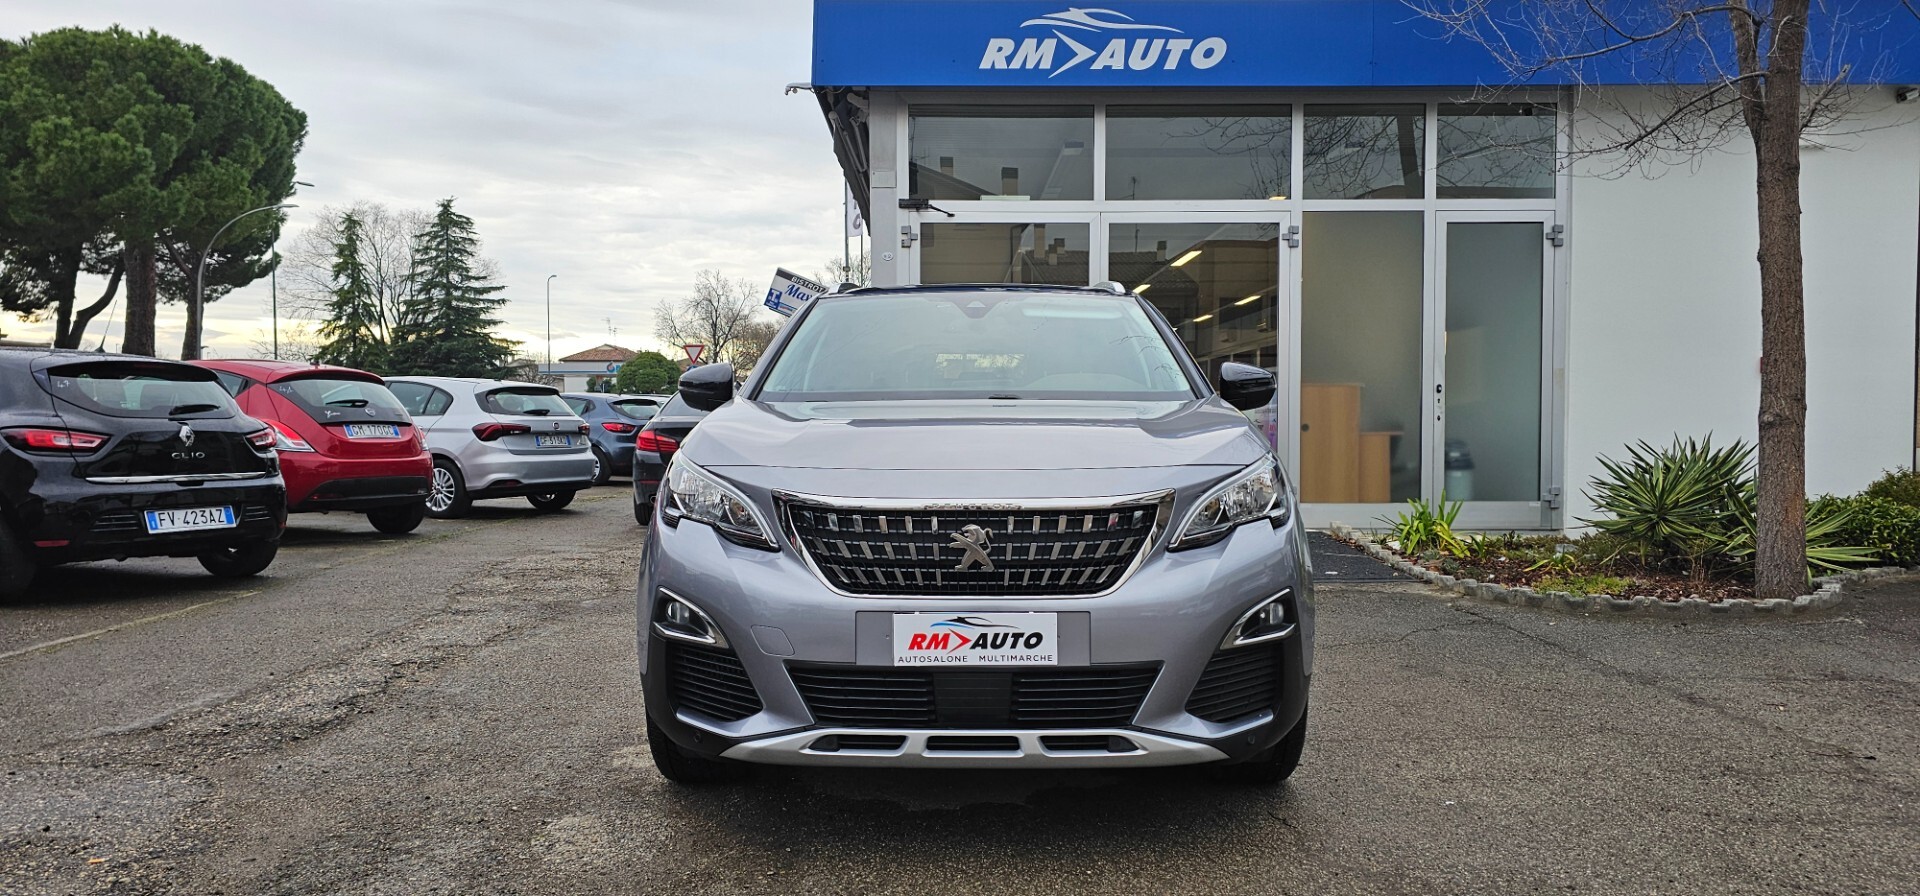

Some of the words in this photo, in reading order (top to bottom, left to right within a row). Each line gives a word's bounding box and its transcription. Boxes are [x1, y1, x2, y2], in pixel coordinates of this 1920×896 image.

[978, 37, 1057, 70] RM
[1089, 36, 1228, 71] AUTO
[171, 451, 206, 460] CLIO
[908, 633, 951, 651] RM
[969, 632, 1044, 650] AUTO
[898, 655, 969, 663] AUTOSALONE
[978, 654, 1053, 662] MULTIMARCHE
